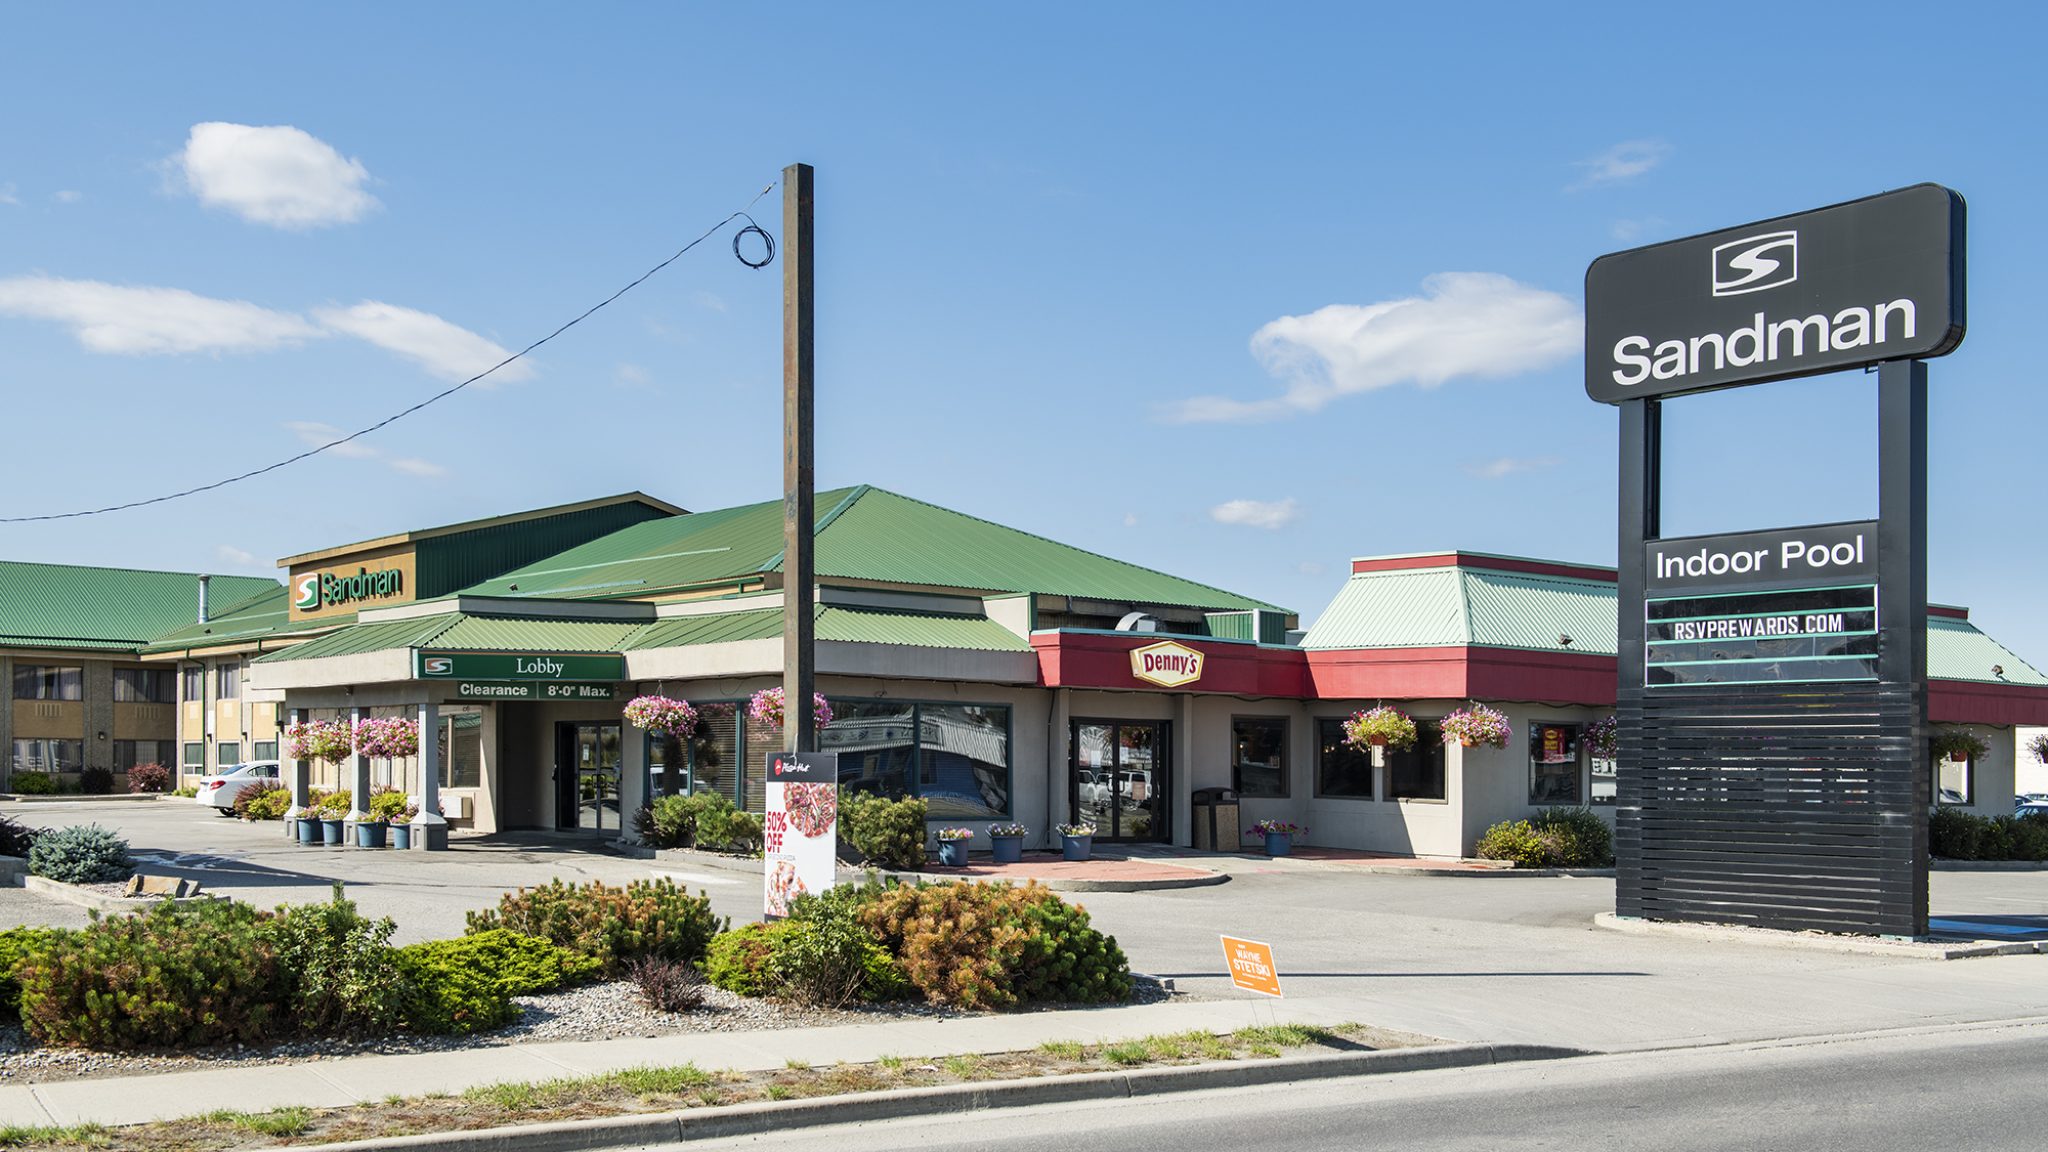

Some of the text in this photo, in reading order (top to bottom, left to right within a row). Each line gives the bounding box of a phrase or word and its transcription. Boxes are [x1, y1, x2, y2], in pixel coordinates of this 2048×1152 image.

[1612, 298, 1916, 386] Sandman
[1657, 534, 1864, 579] Indoor Pool
[322, 567, 401, 603] Sandman
[1675, 613, 1843, 641] RSVPREWARDS.COM
[516, 657, 565, 678] Lobby
[1143, 653, 1198, 676] Denny's
[459, 683, 529, 696] Clearance
[579, 685, 611, 697] Max.
[767, 811, 788, 833] 50%
[766, 832, 783, 854] OFF
